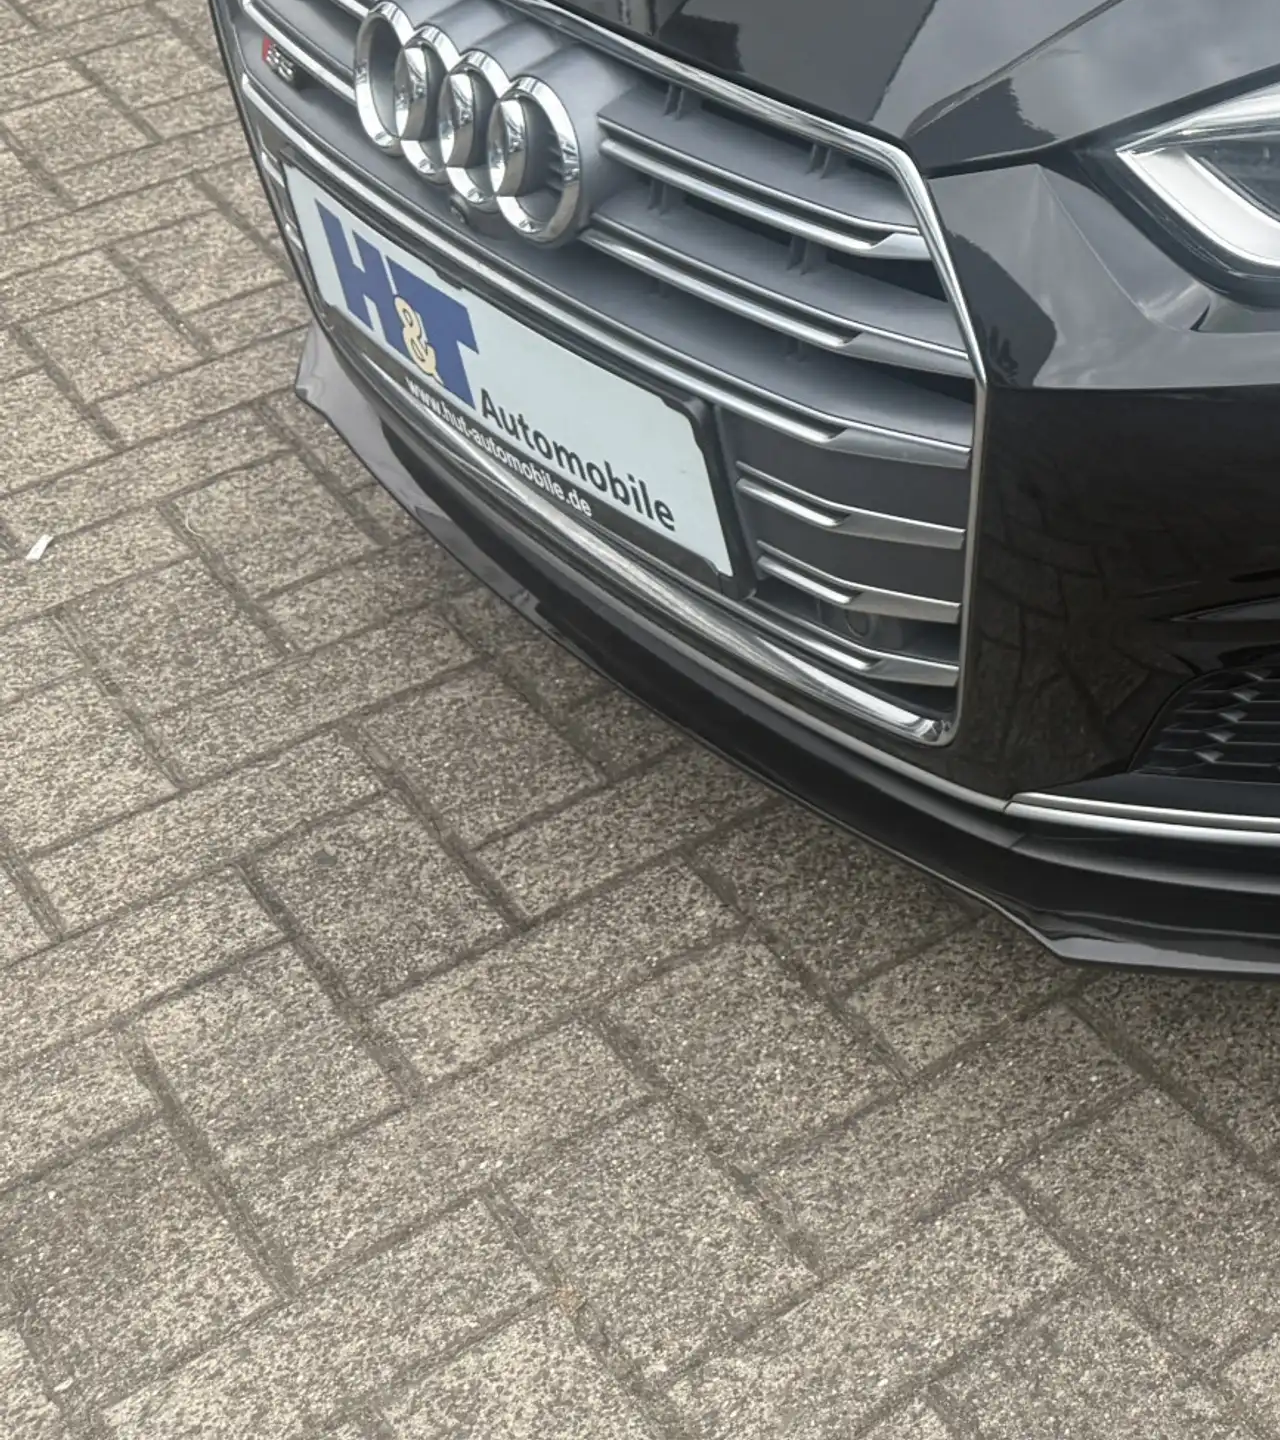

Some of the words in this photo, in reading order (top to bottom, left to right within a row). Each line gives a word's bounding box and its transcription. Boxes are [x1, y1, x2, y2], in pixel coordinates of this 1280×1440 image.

[313, 197, 480, 410] H&T
[480, 387, 677, 532] Automobile
[404, 376, 593, 518] www.hut-automobile.de
